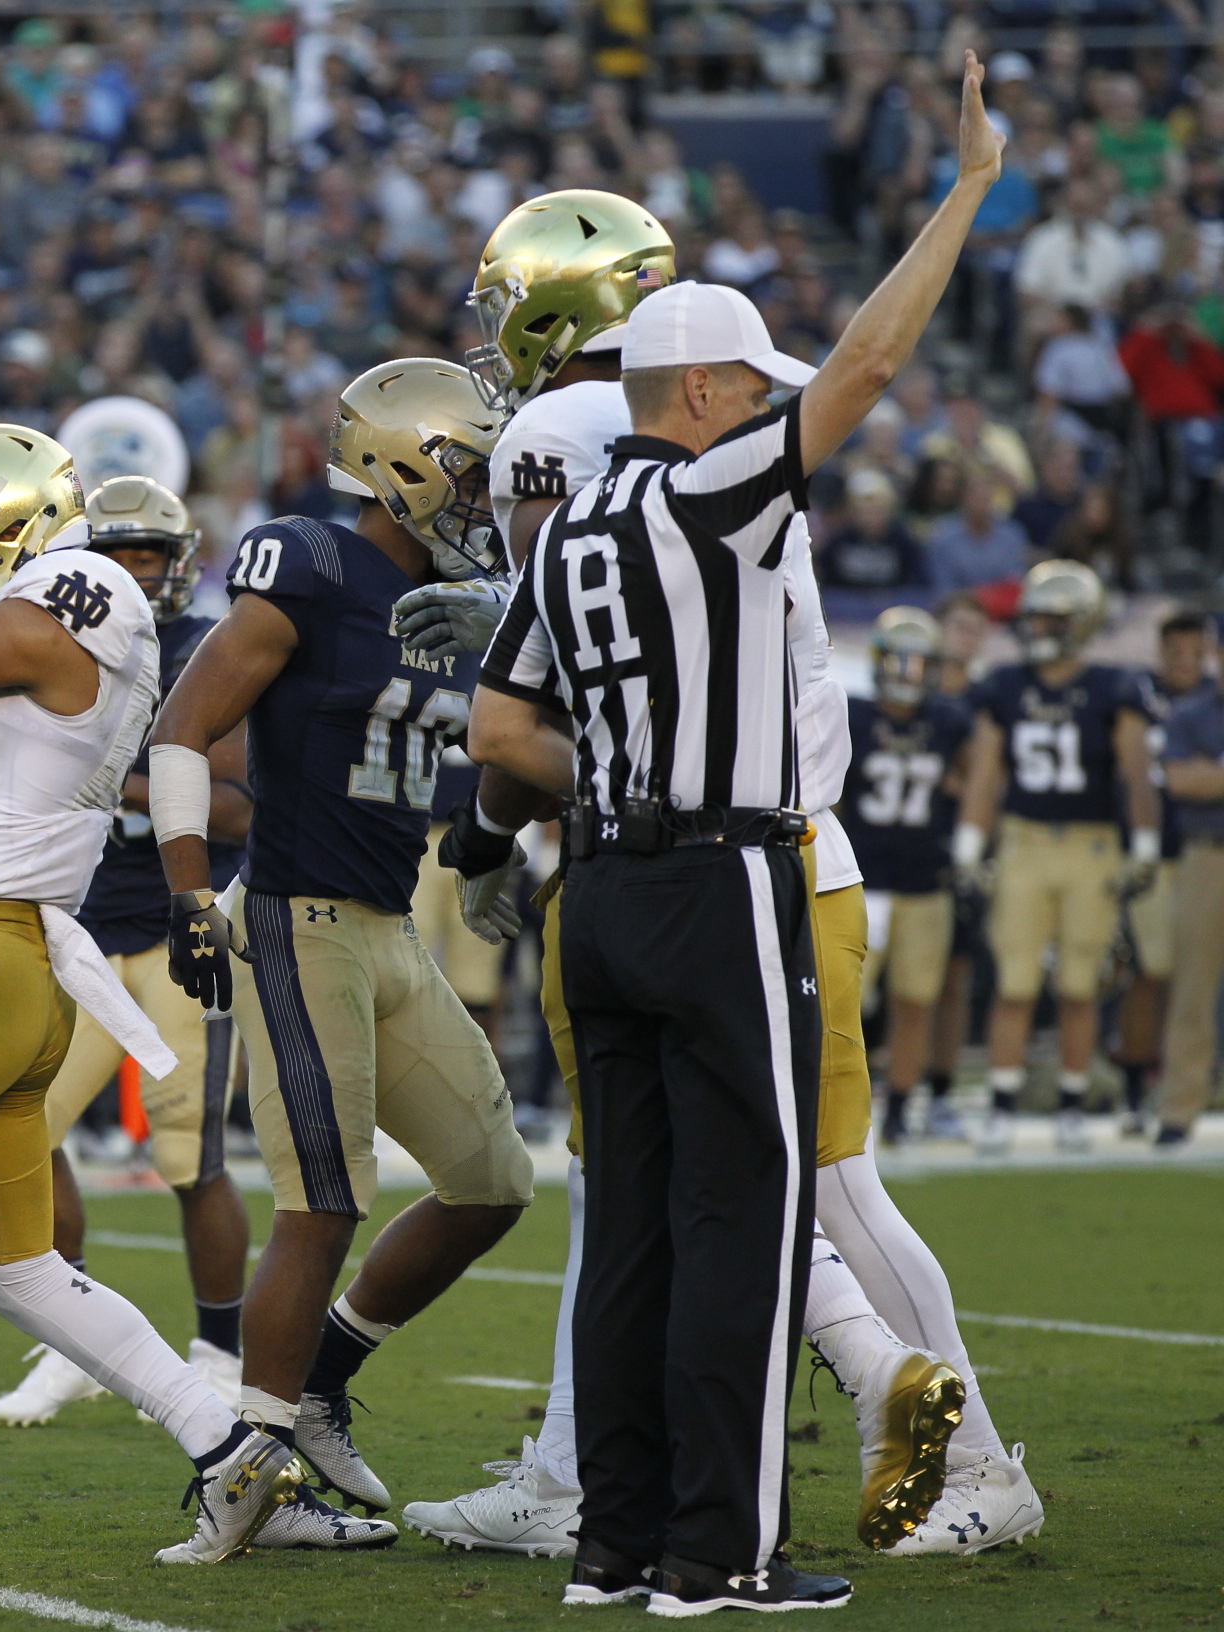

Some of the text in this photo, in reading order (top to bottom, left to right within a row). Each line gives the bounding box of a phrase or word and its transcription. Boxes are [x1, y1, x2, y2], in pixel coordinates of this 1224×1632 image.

[511, 449, 568, 499] ND
[232, 537, 284, 591] 10
[42, 568, 114, 634] ND
[561, 532, 642, 672] R
[400, 642, 456, 677] NAVY
[347, 676, 472, 812] 10
[1012, 719, 1088, 794] 51
[857, 750, 944, 827] 37
[530, 1506, 552, 1517] NITRO
